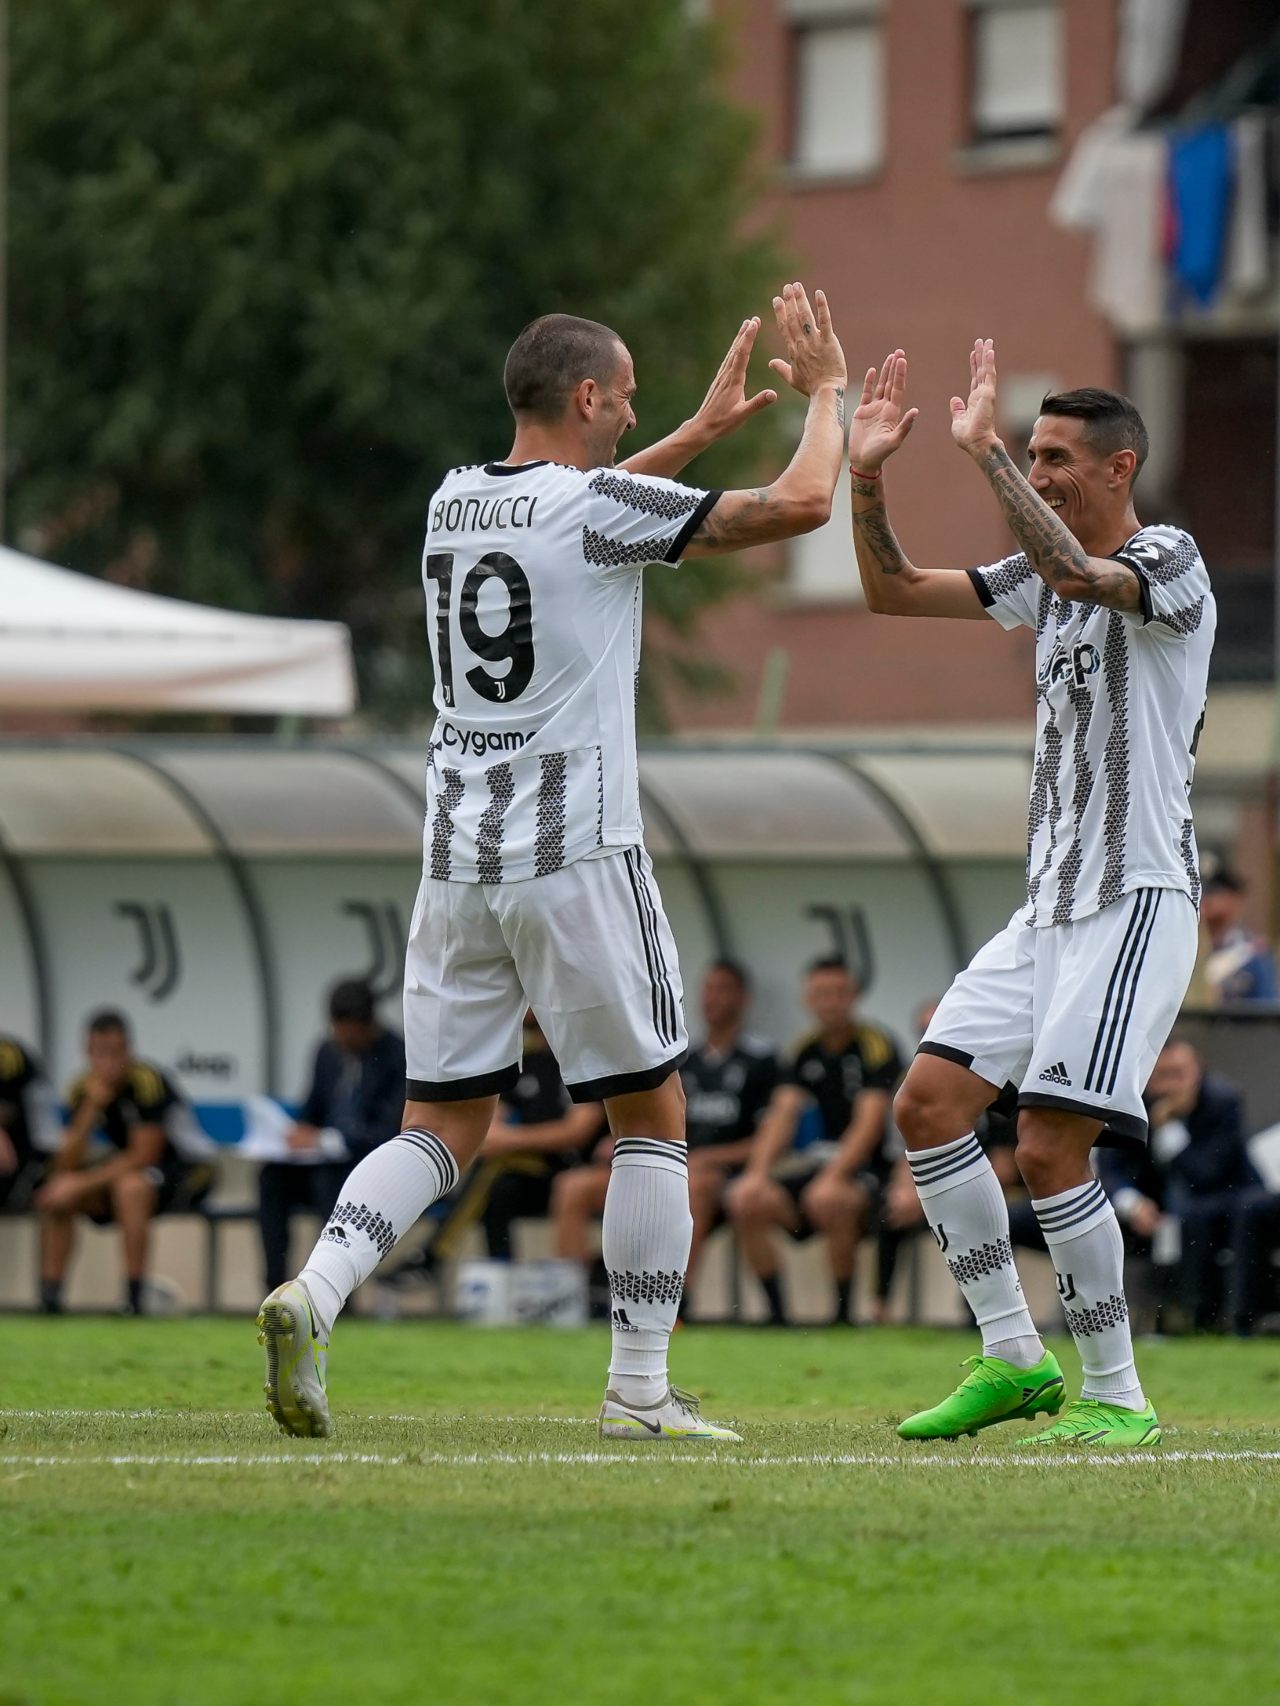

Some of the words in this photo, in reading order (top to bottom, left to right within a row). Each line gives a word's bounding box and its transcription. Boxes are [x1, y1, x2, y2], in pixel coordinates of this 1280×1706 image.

[432, 496, 537, 532] BONUCCI
[426, 552, 535, 707] 19
[1038, 1073, 1072, 1087] adidas
